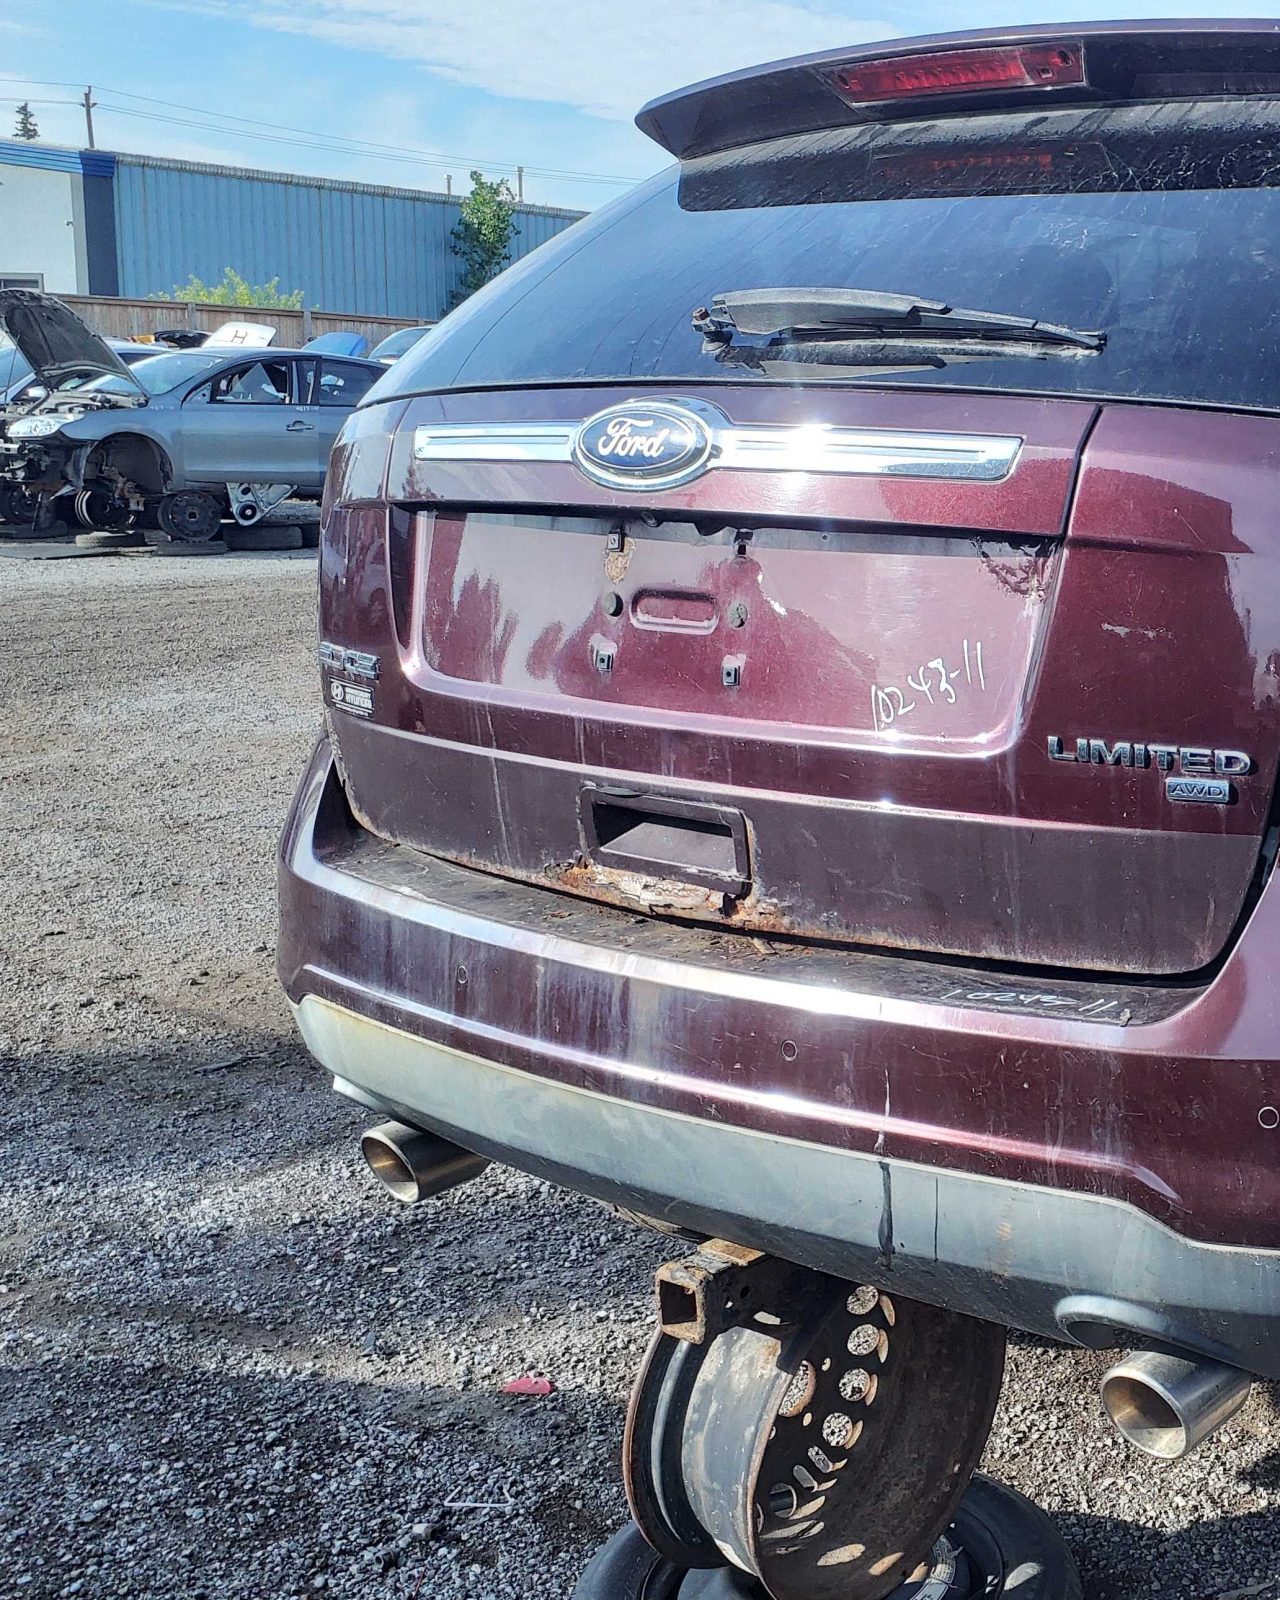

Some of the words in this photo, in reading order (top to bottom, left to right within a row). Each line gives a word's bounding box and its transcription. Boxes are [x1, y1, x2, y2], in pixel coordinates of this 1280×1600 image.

[598, 417, 670, 458] Ford
[1047, 736, 1252, 774] LIMITED
[1170, 782, 1225, 798] AWD
